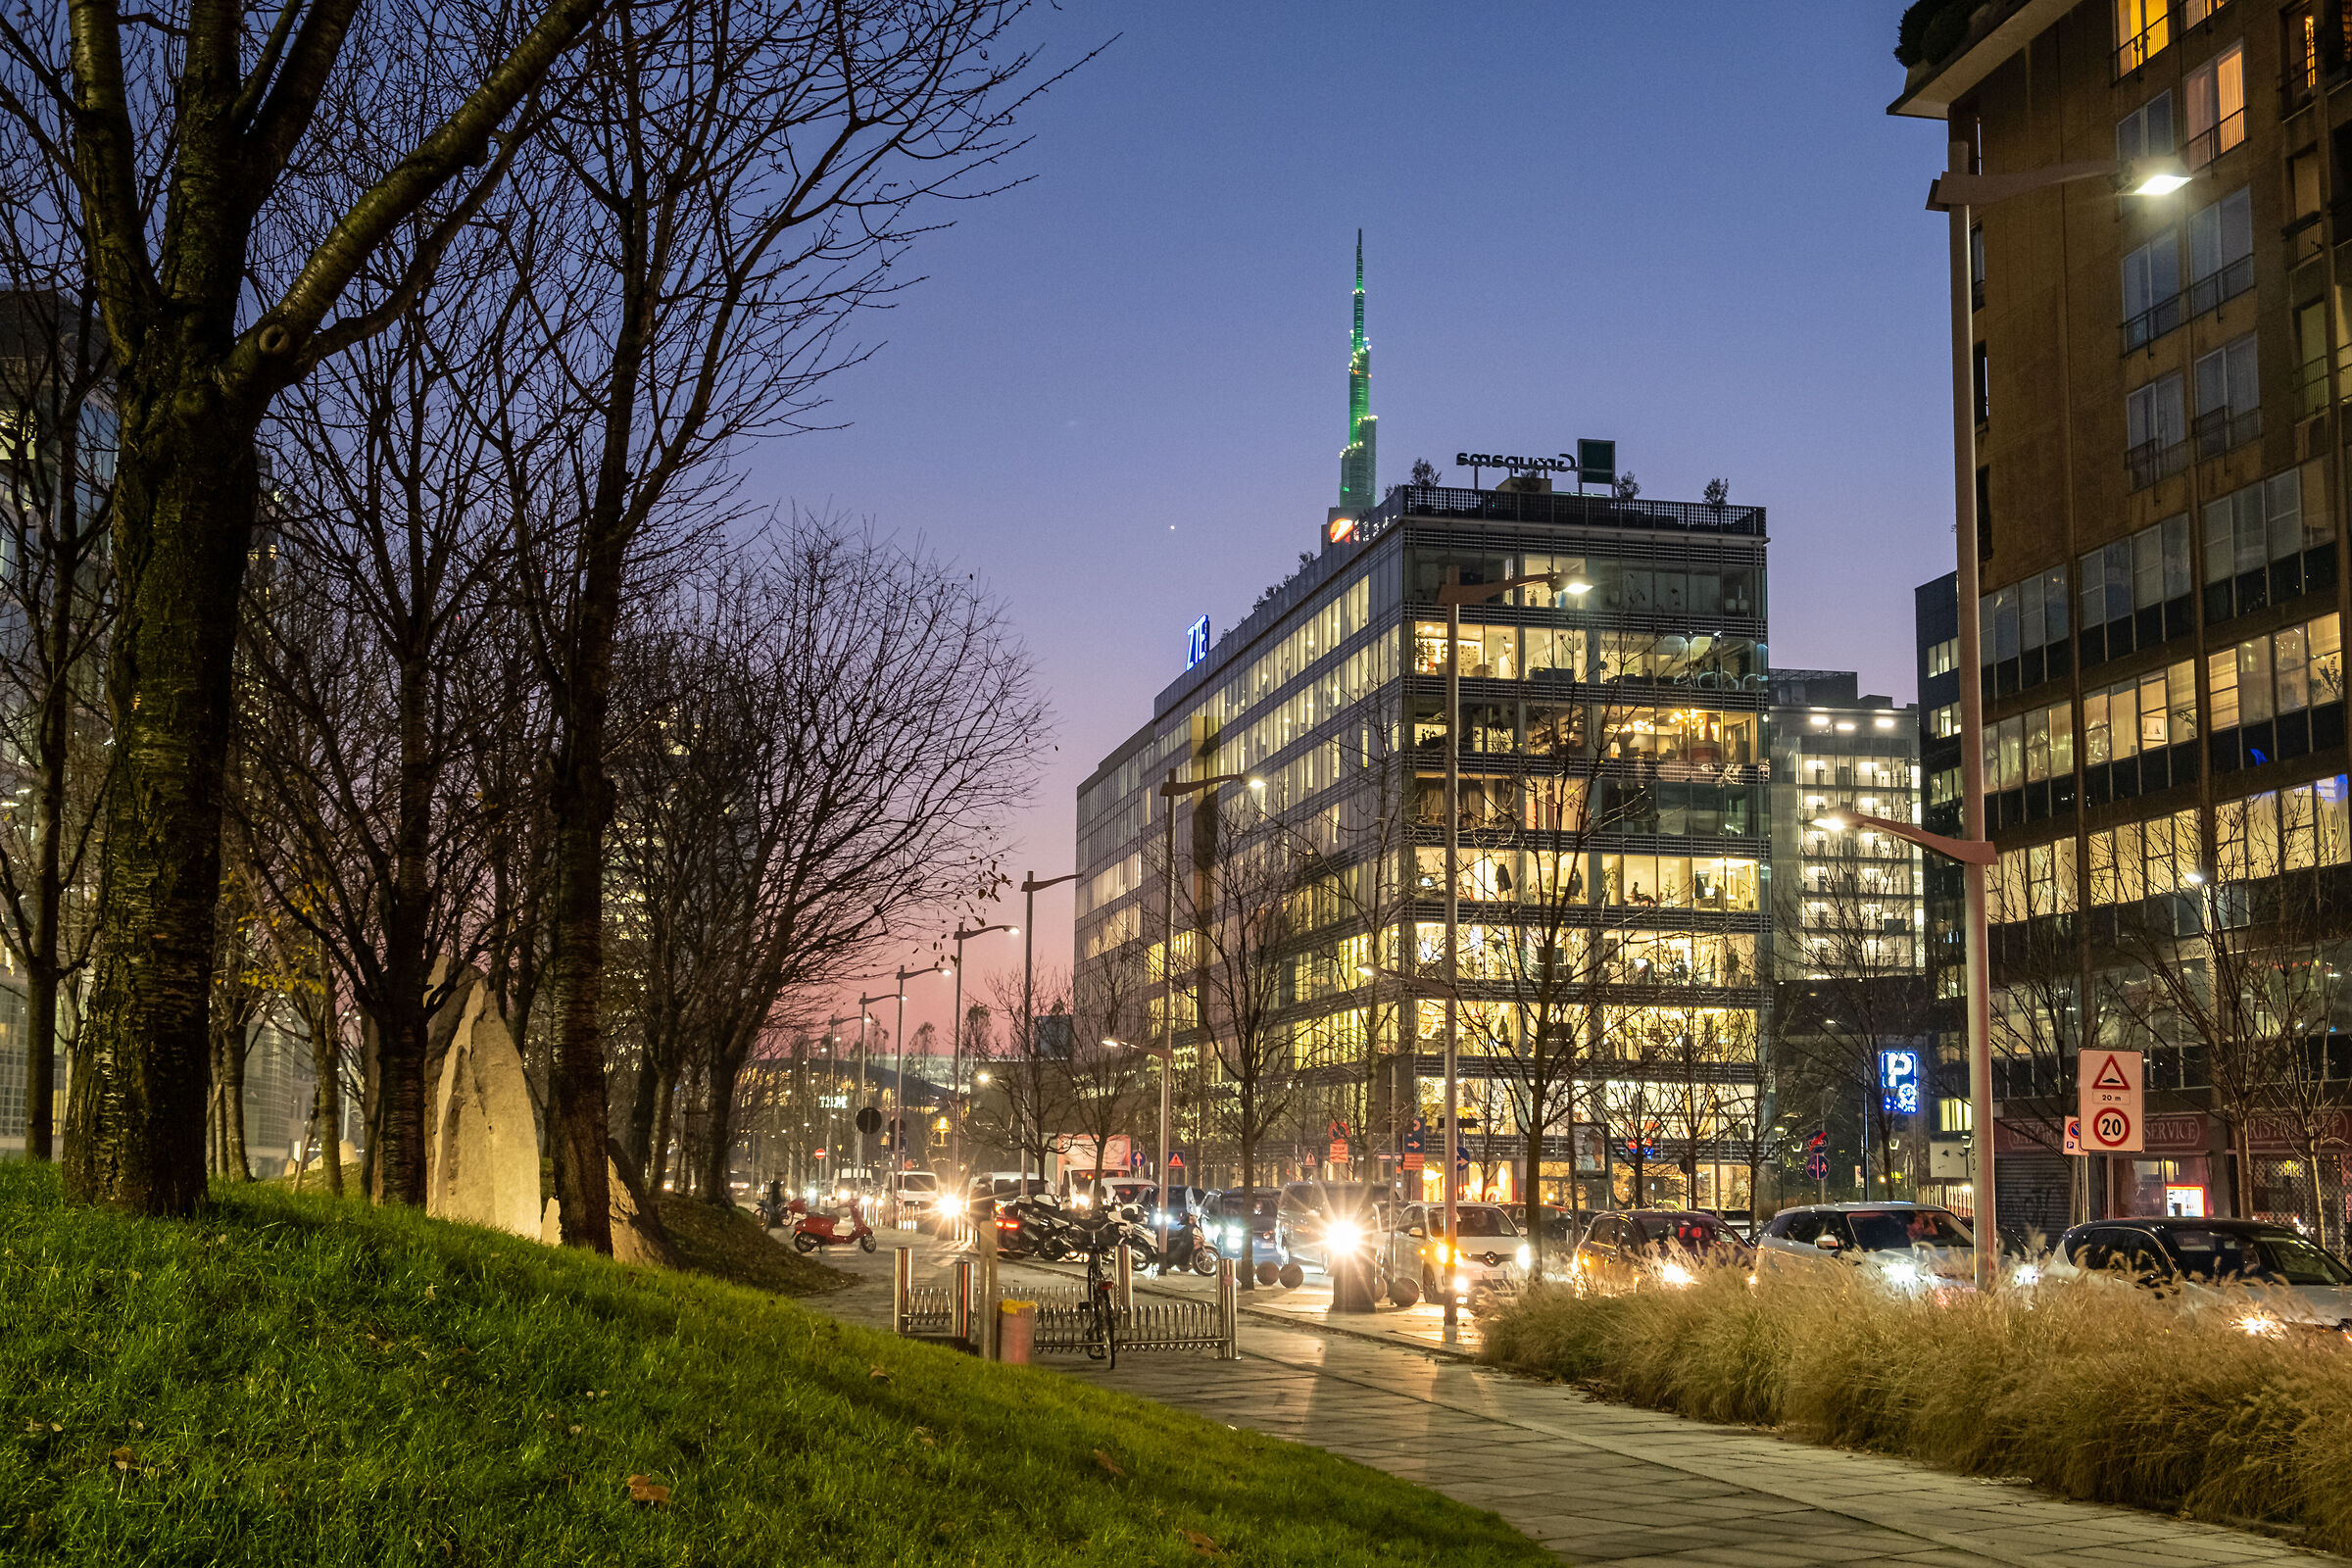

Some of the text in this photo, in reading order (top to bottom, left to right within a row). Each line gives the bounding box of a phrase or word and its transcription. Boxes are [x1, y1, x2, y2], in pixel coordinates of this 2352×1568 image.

[1186, 613, 1207, 671] ZTE
[1887, 1053, 1913, 1088] P
[2101, 1118, 2122, 1136] 20
[2145, 1121, 2196, 1140] SERVICE
